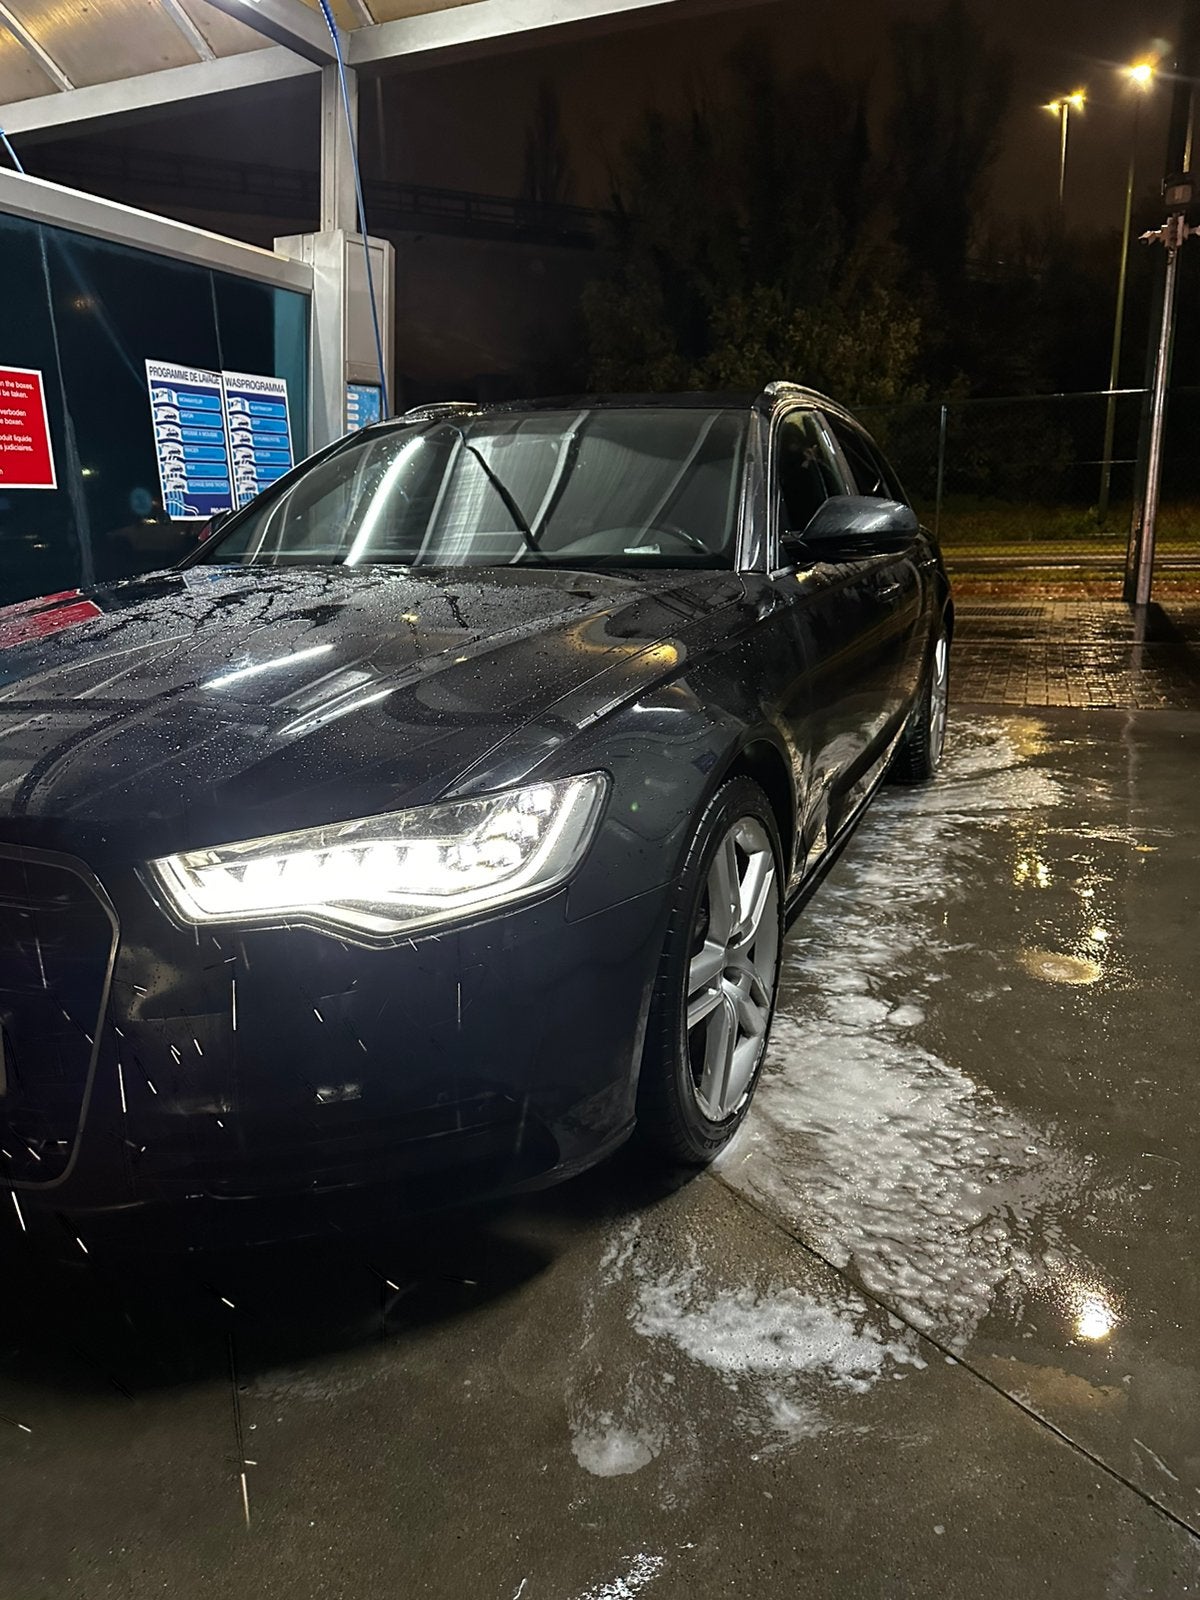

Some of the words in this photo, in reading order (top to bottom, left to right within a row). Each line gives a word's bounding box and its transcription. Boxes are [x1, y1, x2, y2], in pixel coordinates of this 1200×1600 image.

[149, 366, 188, 381] PROGRAMME
[190, 372, 198, 382] DE
[199, 374, 220, 385] LAVAGE
[15, 381, 34, 390] boxes.
[225, 377, 285, 393] WASPROGRAMMA
[2, 389, 11, 397] be
[11, 390, 28, 398] taken.
[14, 434, 32, 443] liquide
[4, 444, 33, 452] judiciaires.
